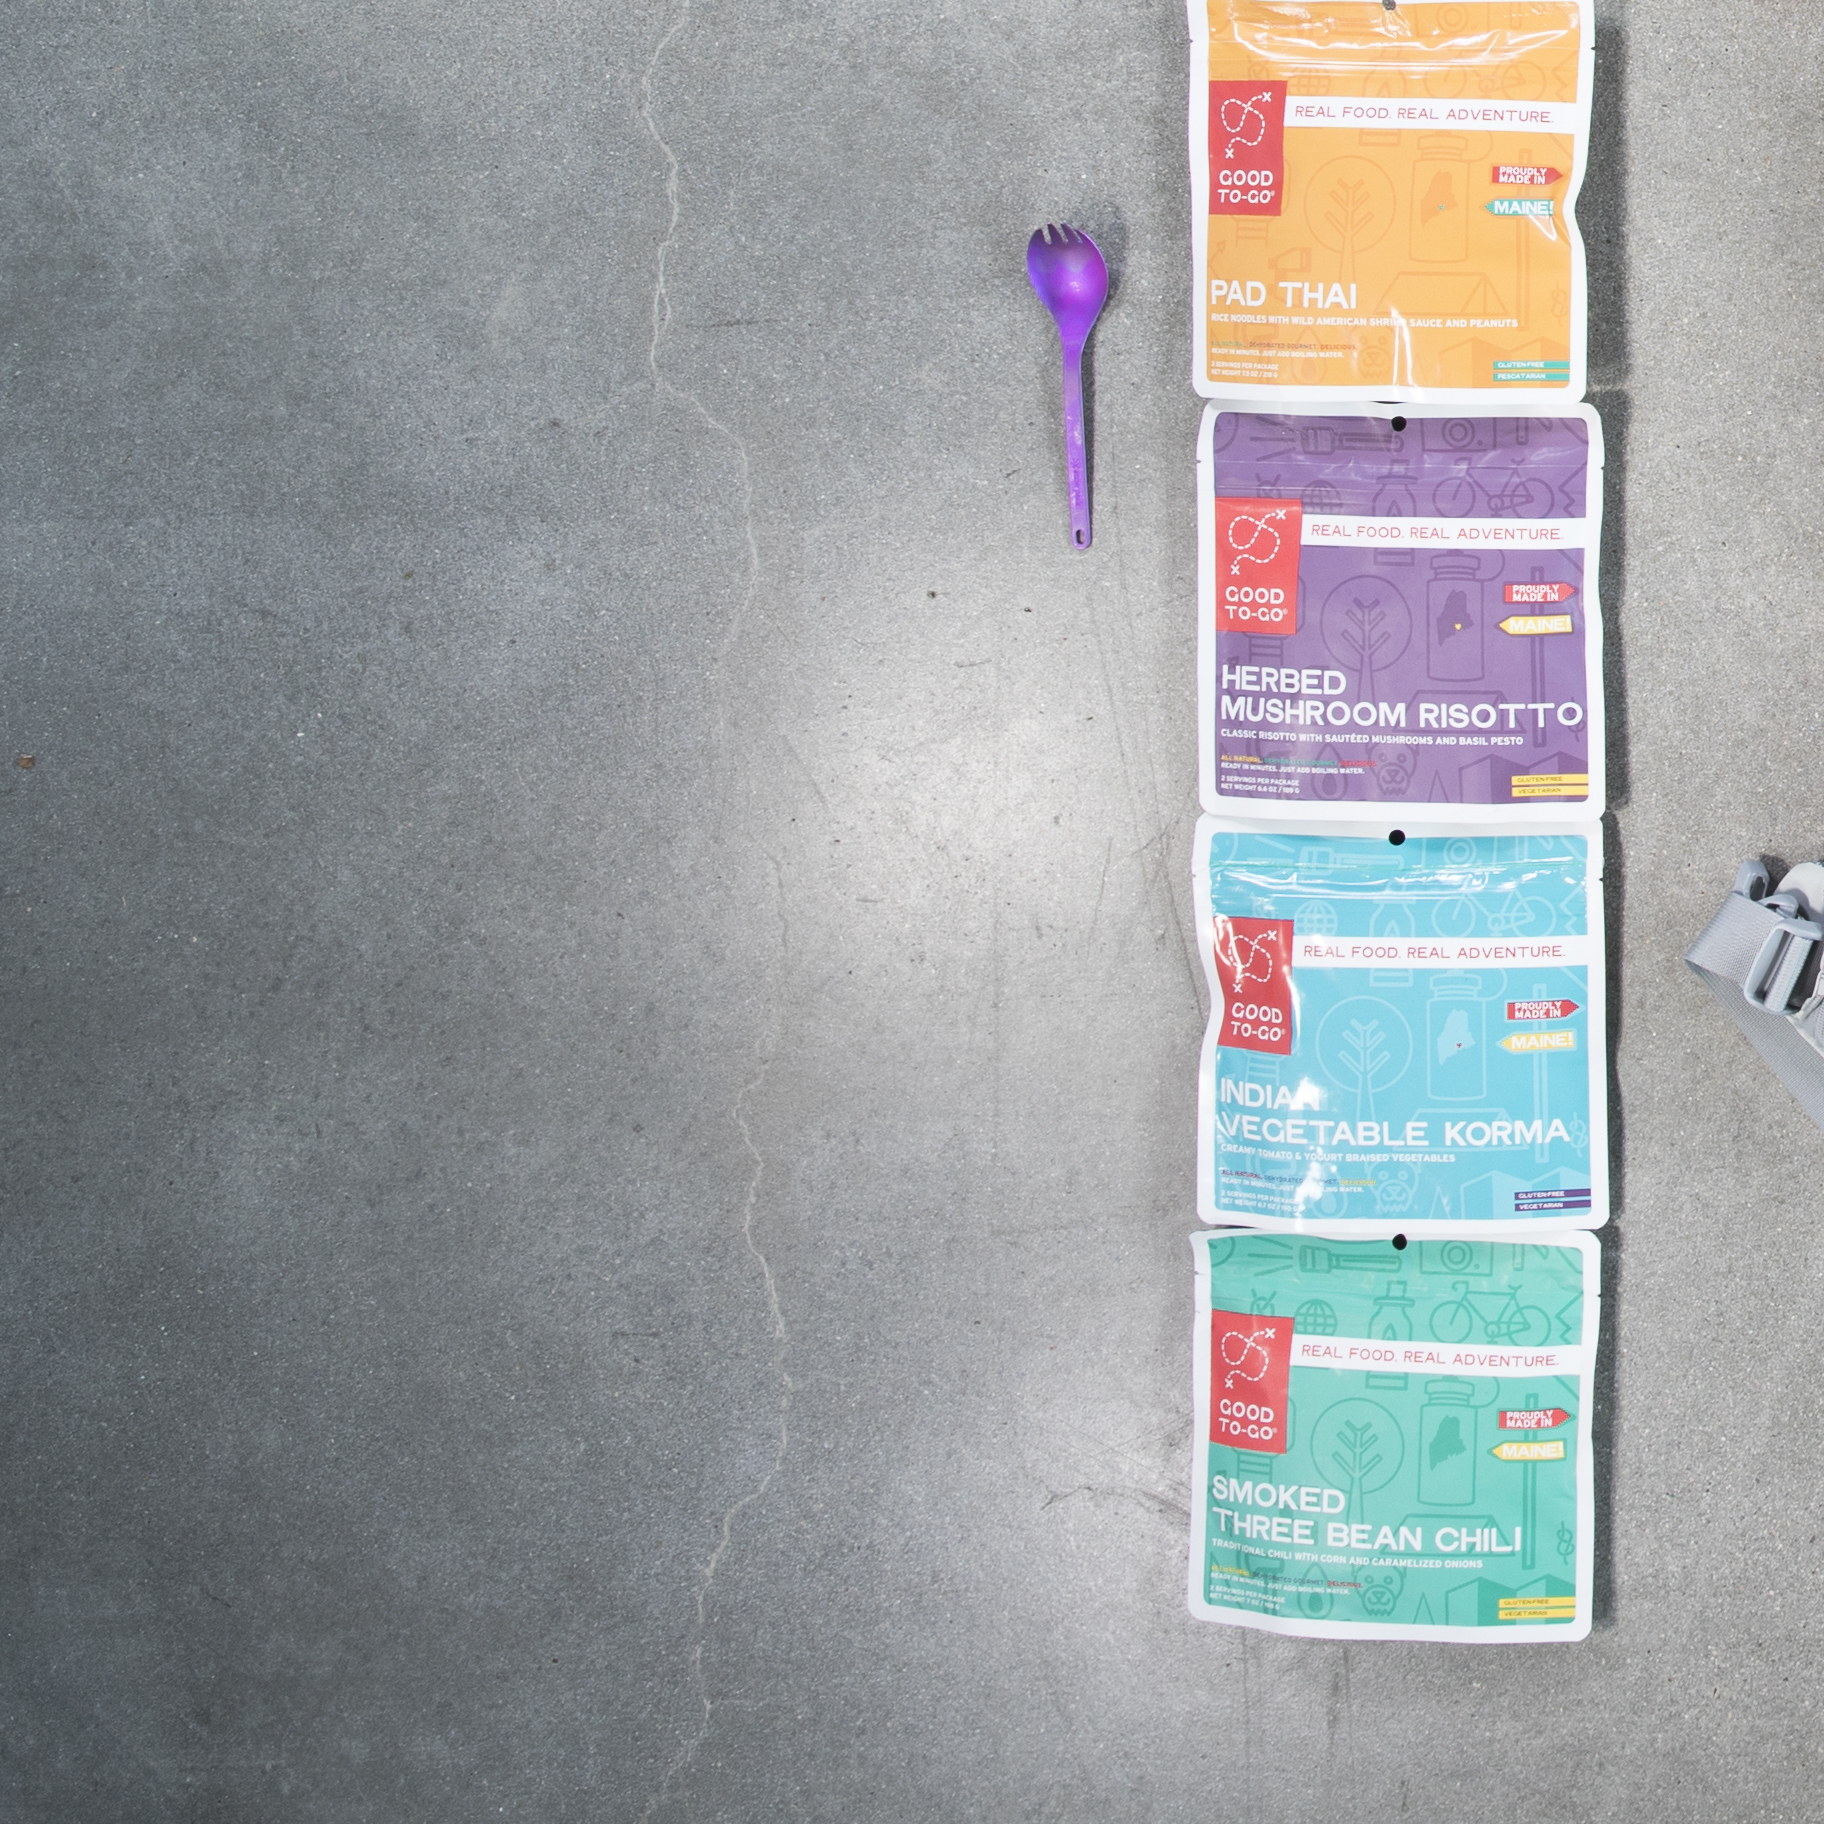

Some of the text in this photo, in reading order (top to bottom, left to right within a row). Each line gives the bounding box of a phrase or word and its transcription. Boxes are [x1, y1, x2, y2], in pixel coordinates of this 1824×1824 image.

[1294, 106, 1554, 124] REAL FOOD. REAL ADVENTURE.
[1219, 170, 1274, 187] GOOD
[1498, 174, 1546, 185] MADE IN
[1499, 166, 1548, 178] PROUDLY
[1493, 199, 1554, 216] MAINE!
[1210, 279, 1358, 310] PAD THAI
[1210, 312, 1228, 323] RICE
[1230, 313, 1266, 324] NOODLES
[1268, 314, 1289, 325] WITH
[1290, 315, 1314, 326] WILD
[1315, 316, 1367, 327] AMERICAN
[1408, 317, 1442, 328] SAUCE
[1445, 318, 1467, 328] AND
[1469, 318, 1519, 328] PEANUTS
[1311, 524, 1564, 541] REAL FOOD. REAL ADVENTURE.
[1225, 586, 1285, 605] GOOD
[1512, 584, 1560, 596] PROUDLY
[1512, 592, 1559, 602] MADE IN
[1509, 615, 1572, 634] MAINE!
[1221, 665, 1347, 695] HERBED
[1220, 696, 1584, 729] MUSHROOM RISOTTO
[1220, 727, 1524, 746] CLASSIC RISOTTO WITH SAUTÉED MUSHROOMS AND BASIL PESTO
[1279, 764, 1295, 773] JUST
[1295, 765, 1310, 773] ADD
[1256, 776, 1269, 785] PER
[1303, 945, 1566, 959] REAL FOOD. REAL ADVENTURE.
[1231, 1002, 1283, 1025] GOOD
[1514, 1001, 1562, 1014] PROUDLY
[1514, 1008, 1562, 1020] MADE IN
[1510, 1031, 1574, 1050] MAINE!
[1221, 1111, 1571, 1147] VEGETABLE KORMA
[1220, 1142, 1456, 1164] CREAMY TOMATO & YOGURT BRAISED VEGETABLES
[1301, 1345, 1559, 1368] REAL FOOD. REAL ADVENTURE.
[1219, 1399, 1275, 1424] GOOD
[1505, 1409, 1554, 1422] PROUDLY
[1506, 1418, 1553, 1429] MADE IN
[1501, 1441, 1564, 1460] MAINE!
[1212, 1475, 1346, 1515] SMOKED
[1212, 1506, 1522, 1553] THREE BEAN CHILI
[1211, 1537, 1483, 1569] TRADITIONAL CHILI WITH CORN AND CARAMELIZED ONIONS
